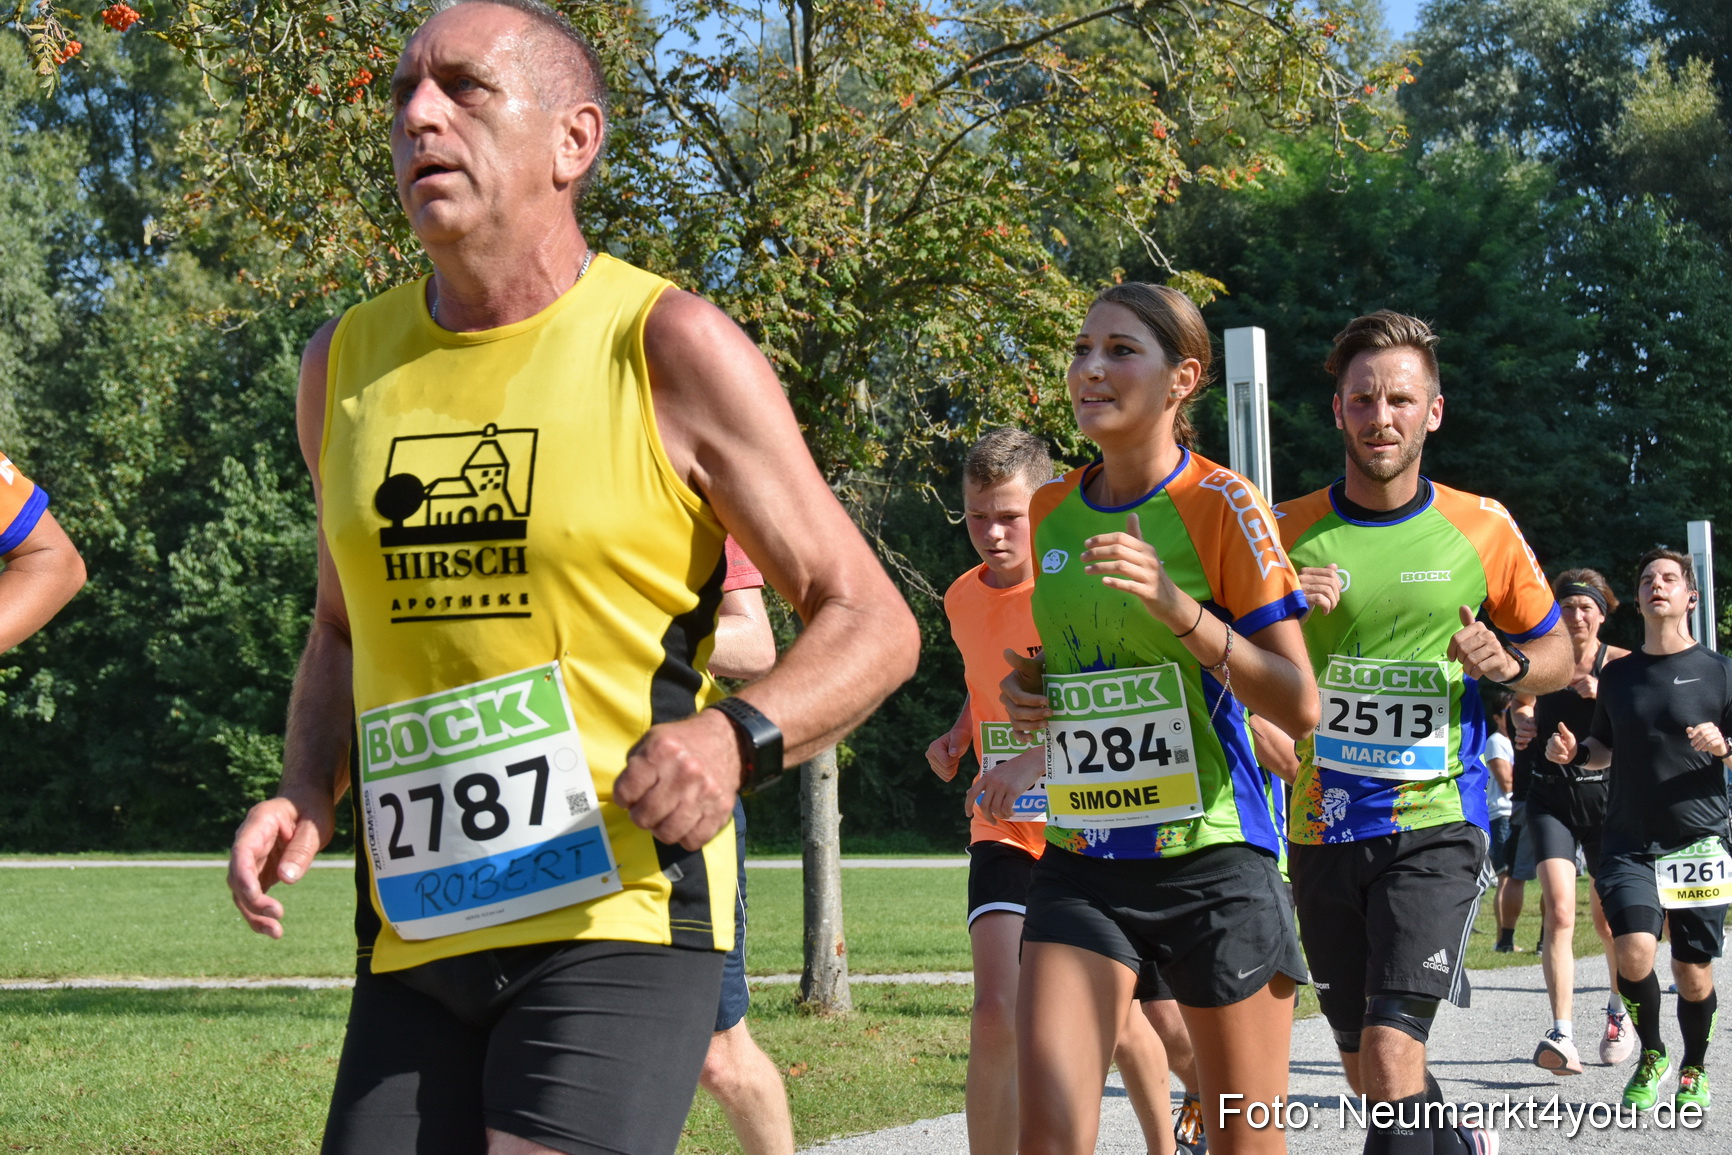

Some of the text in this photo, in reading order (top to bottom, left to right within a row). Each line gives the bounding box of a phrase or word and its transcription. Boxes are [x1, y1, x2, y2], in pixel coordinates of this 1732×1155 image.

[1199, 468, 1287, 581] BOCK
[383, 546, 529, 581] HIRSCH
[1400, 570, 1451, 583] BOCK
[391, 593, 530, 610] APOTHEKE
[1325, 661, 1440, 692] BOCK
[1047, 672, 1170, 716] BOCK
[366, 680, 551, 773] BOCK
[1173, 721, 1182, 732] C
[1328, 697, 1433, 739] 2513
[1056, 722, 1172, 775] 1284
[1341, 745, 1416, 766] MARCO
[379, 754, 550, 861] 2787
[1069, 785, 1161, 811] SIMONE
[415, 839, 598, 917] ROBERT
[1666, 860, 1725, 884] 1261
[1677, 888, 1720, 900] MARCO
[1422, 960, 1450, 974] adidas
